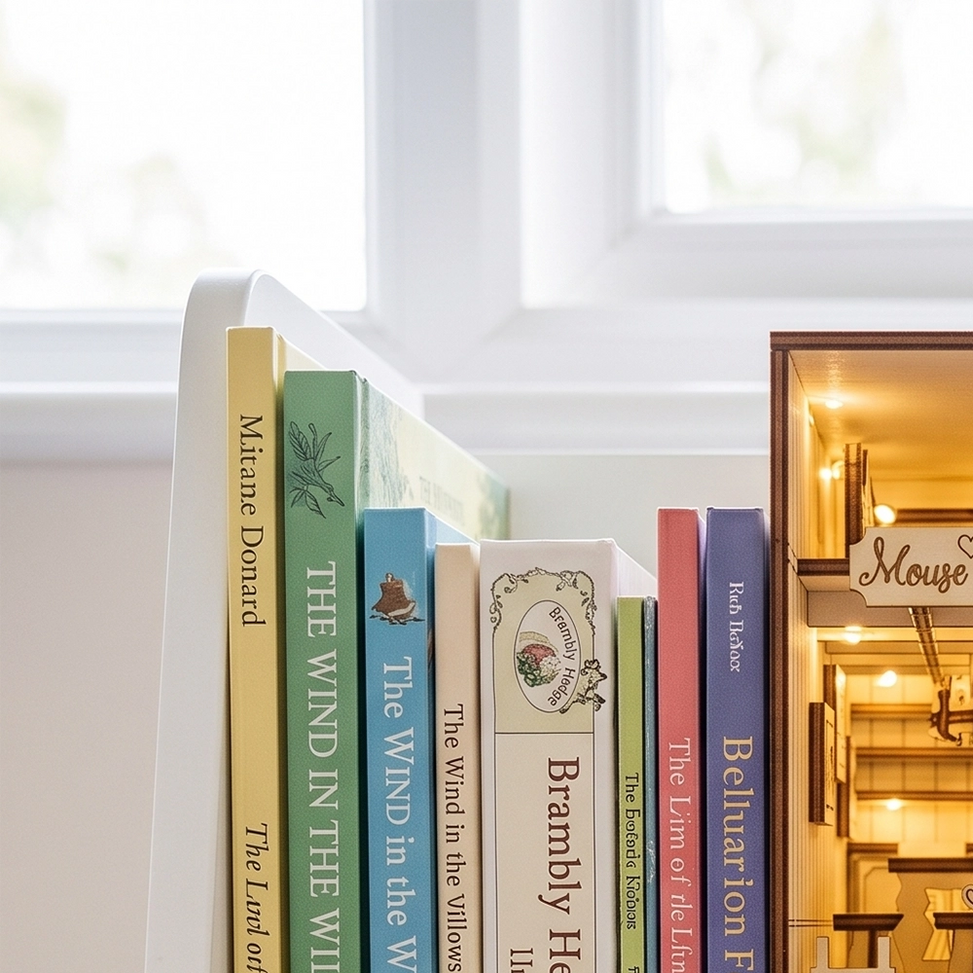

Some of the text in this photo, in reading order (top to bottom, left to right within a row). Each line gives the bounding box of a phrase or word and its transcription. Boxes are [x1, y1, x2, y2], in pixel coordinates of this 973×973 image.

[241, 525, 266, 627] Donard
[858, 536, 969, 594] Mouse
[306, 560, 337, 638] THE
[307, 648, 338, 758] WIND
[383, 656, 413, 718] The
[444, 703, 464, 749] The
[383, 726, 415, 826] WIND
[444, 756, 466, 815] Wind
[625, 772, 640, 803] The
[668, 737, 691, 786] The
[307, 768, 339, 810] IN
[244, 822, 269, 872] The
[308, 819, 340, 898] THE
[385, 835, 415, 866] in
[445, 823, 465, 844] in
[537, 756, 583, 916] Brambly
[446, 852, 467, 887] the
[386, 875, 416, 926] the
